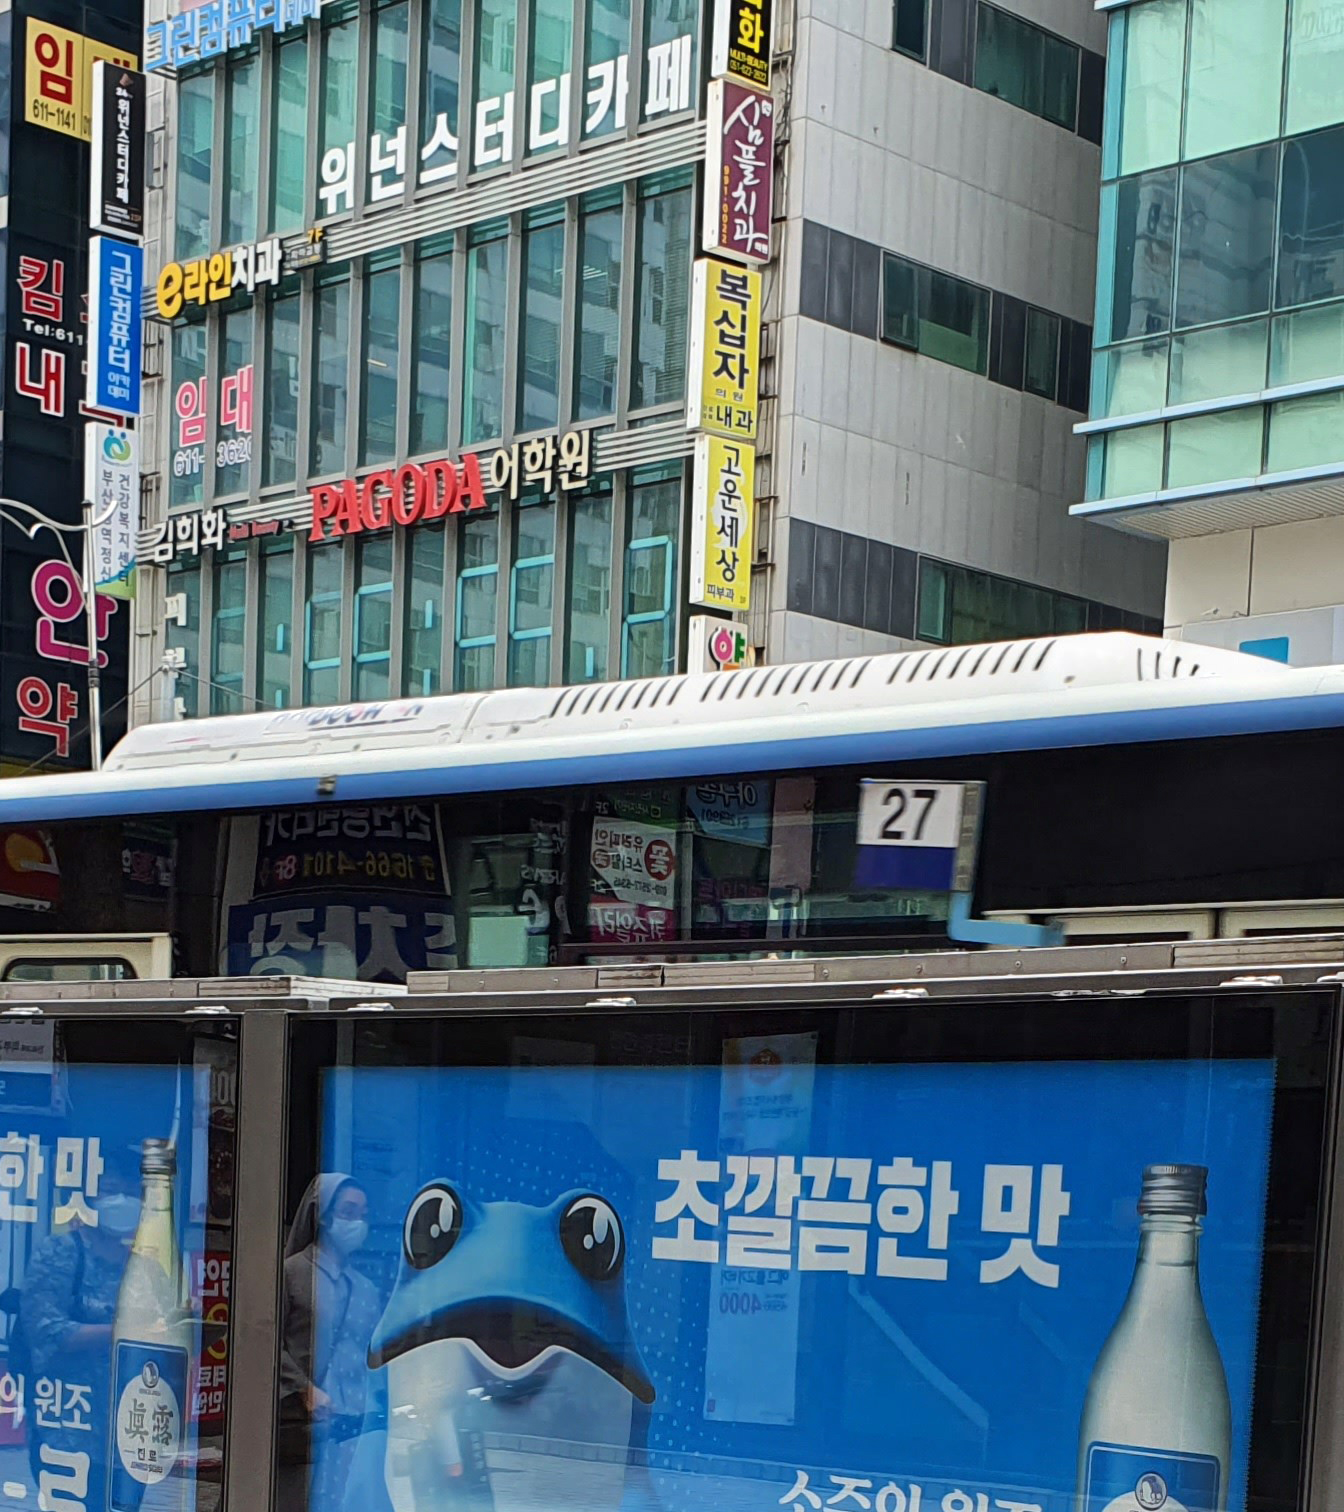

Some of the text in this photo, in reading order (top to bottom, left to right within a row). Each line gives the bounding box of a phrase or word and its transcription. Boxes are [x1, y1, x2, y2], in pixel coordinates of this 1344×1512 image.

[32, 98, 76, 131] 611-1141
[319, 34, 692, 214] 위넌스터디카페
[156, 237, 282, 319] e라인치과
[712, 268, 752, 390] 복십자
[175, 364, 253, 448] 임대
[716, 404, 753, 434] 내과
[308, 429, 591, 542] PAGODA 어학원
[714, 444, 742, 583] 고운세상
[153, 506, 227, 562] 김희화
[16, 676, 78, 757] 약
[879, 788, 939, 841] 27
[54, 1136, 104, 1228] 맛
[651, 1148, 1072, 1289] 초깔끔한 맛
[33, 1375, 94, 1434] 원조
